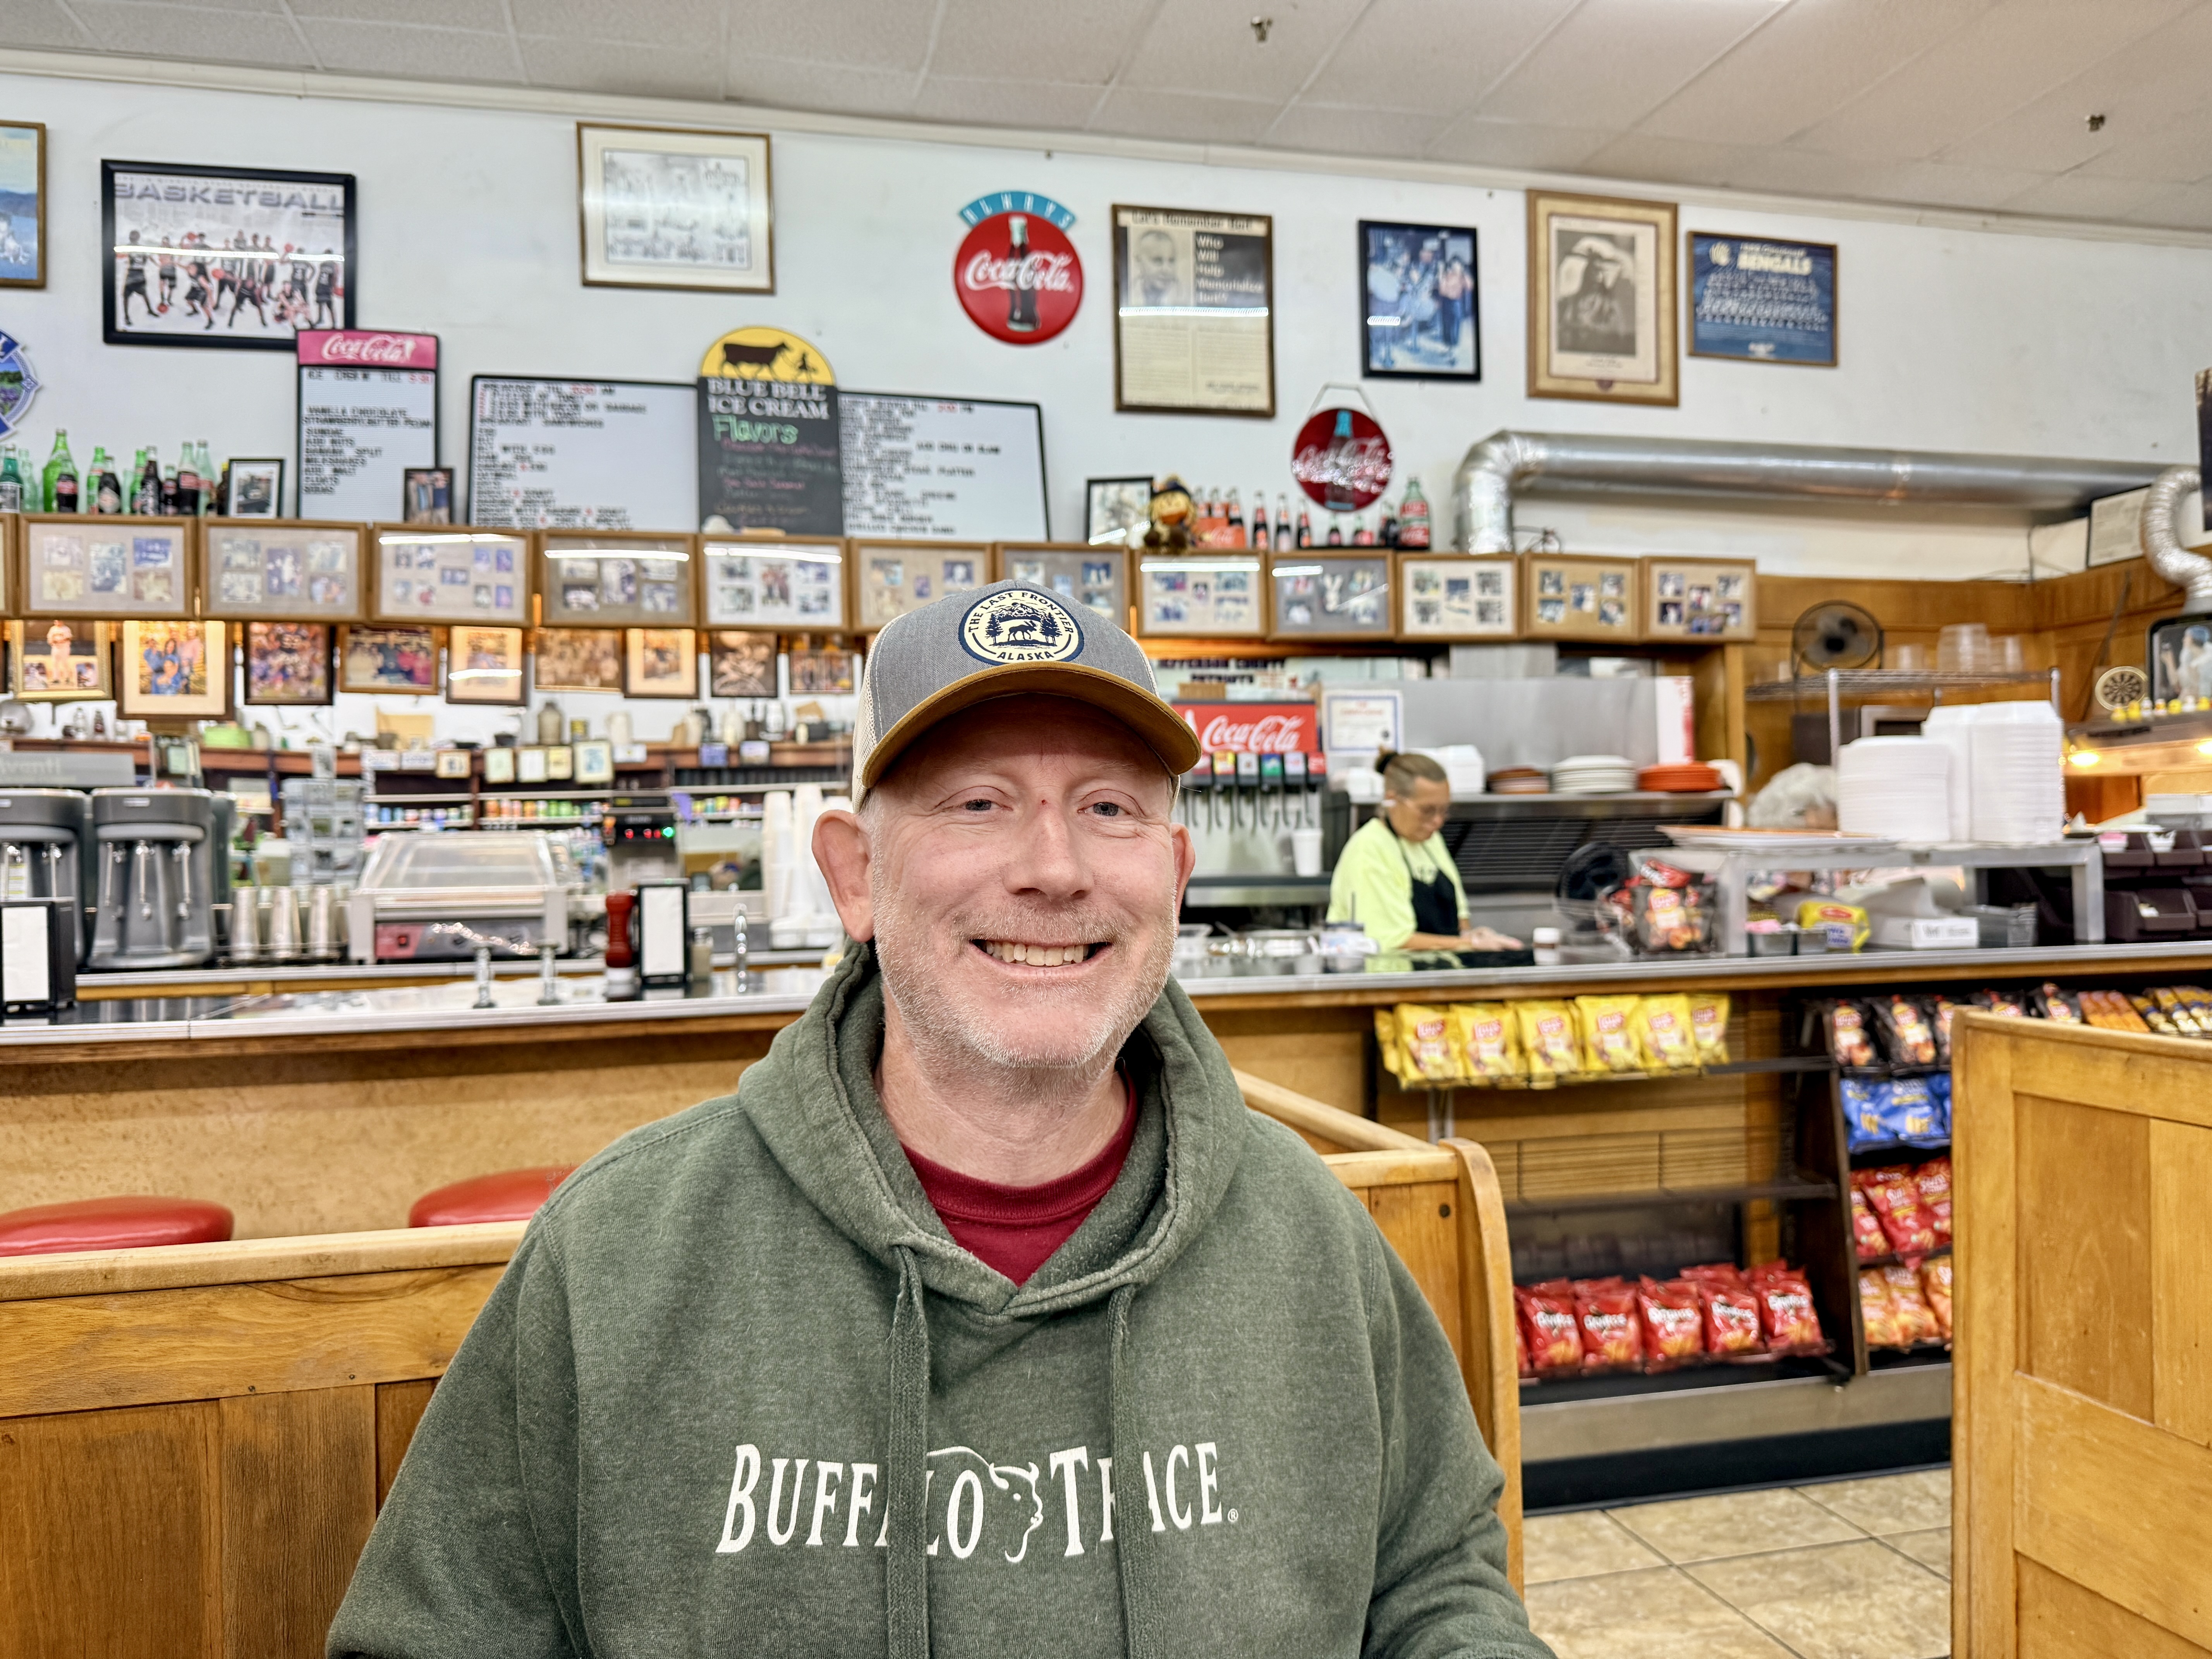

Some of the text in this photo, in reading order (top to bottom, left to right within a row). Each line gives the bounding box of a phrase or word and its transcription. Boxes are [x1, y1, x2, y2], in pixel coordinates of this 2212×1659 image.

[115, 183, 343, 211] BASKETBALL
[964, 250, 1073, 291] Coca-Cola
[321, 332, 407, 361] Coca-Cola
[708, 377, 826, 401] BLUE BELL
[708, 394, 830, 420] ICE CREAM
[712, 414, 799, 444] Flavors
[969, 592, 1073, 633] THE LAST FRONTIER
[997, 651, 1054, 661] ALASKA
[1202, 714, 1305, 753] Coca-Cola
[715, 1443, 984, 1558] BUFFO
